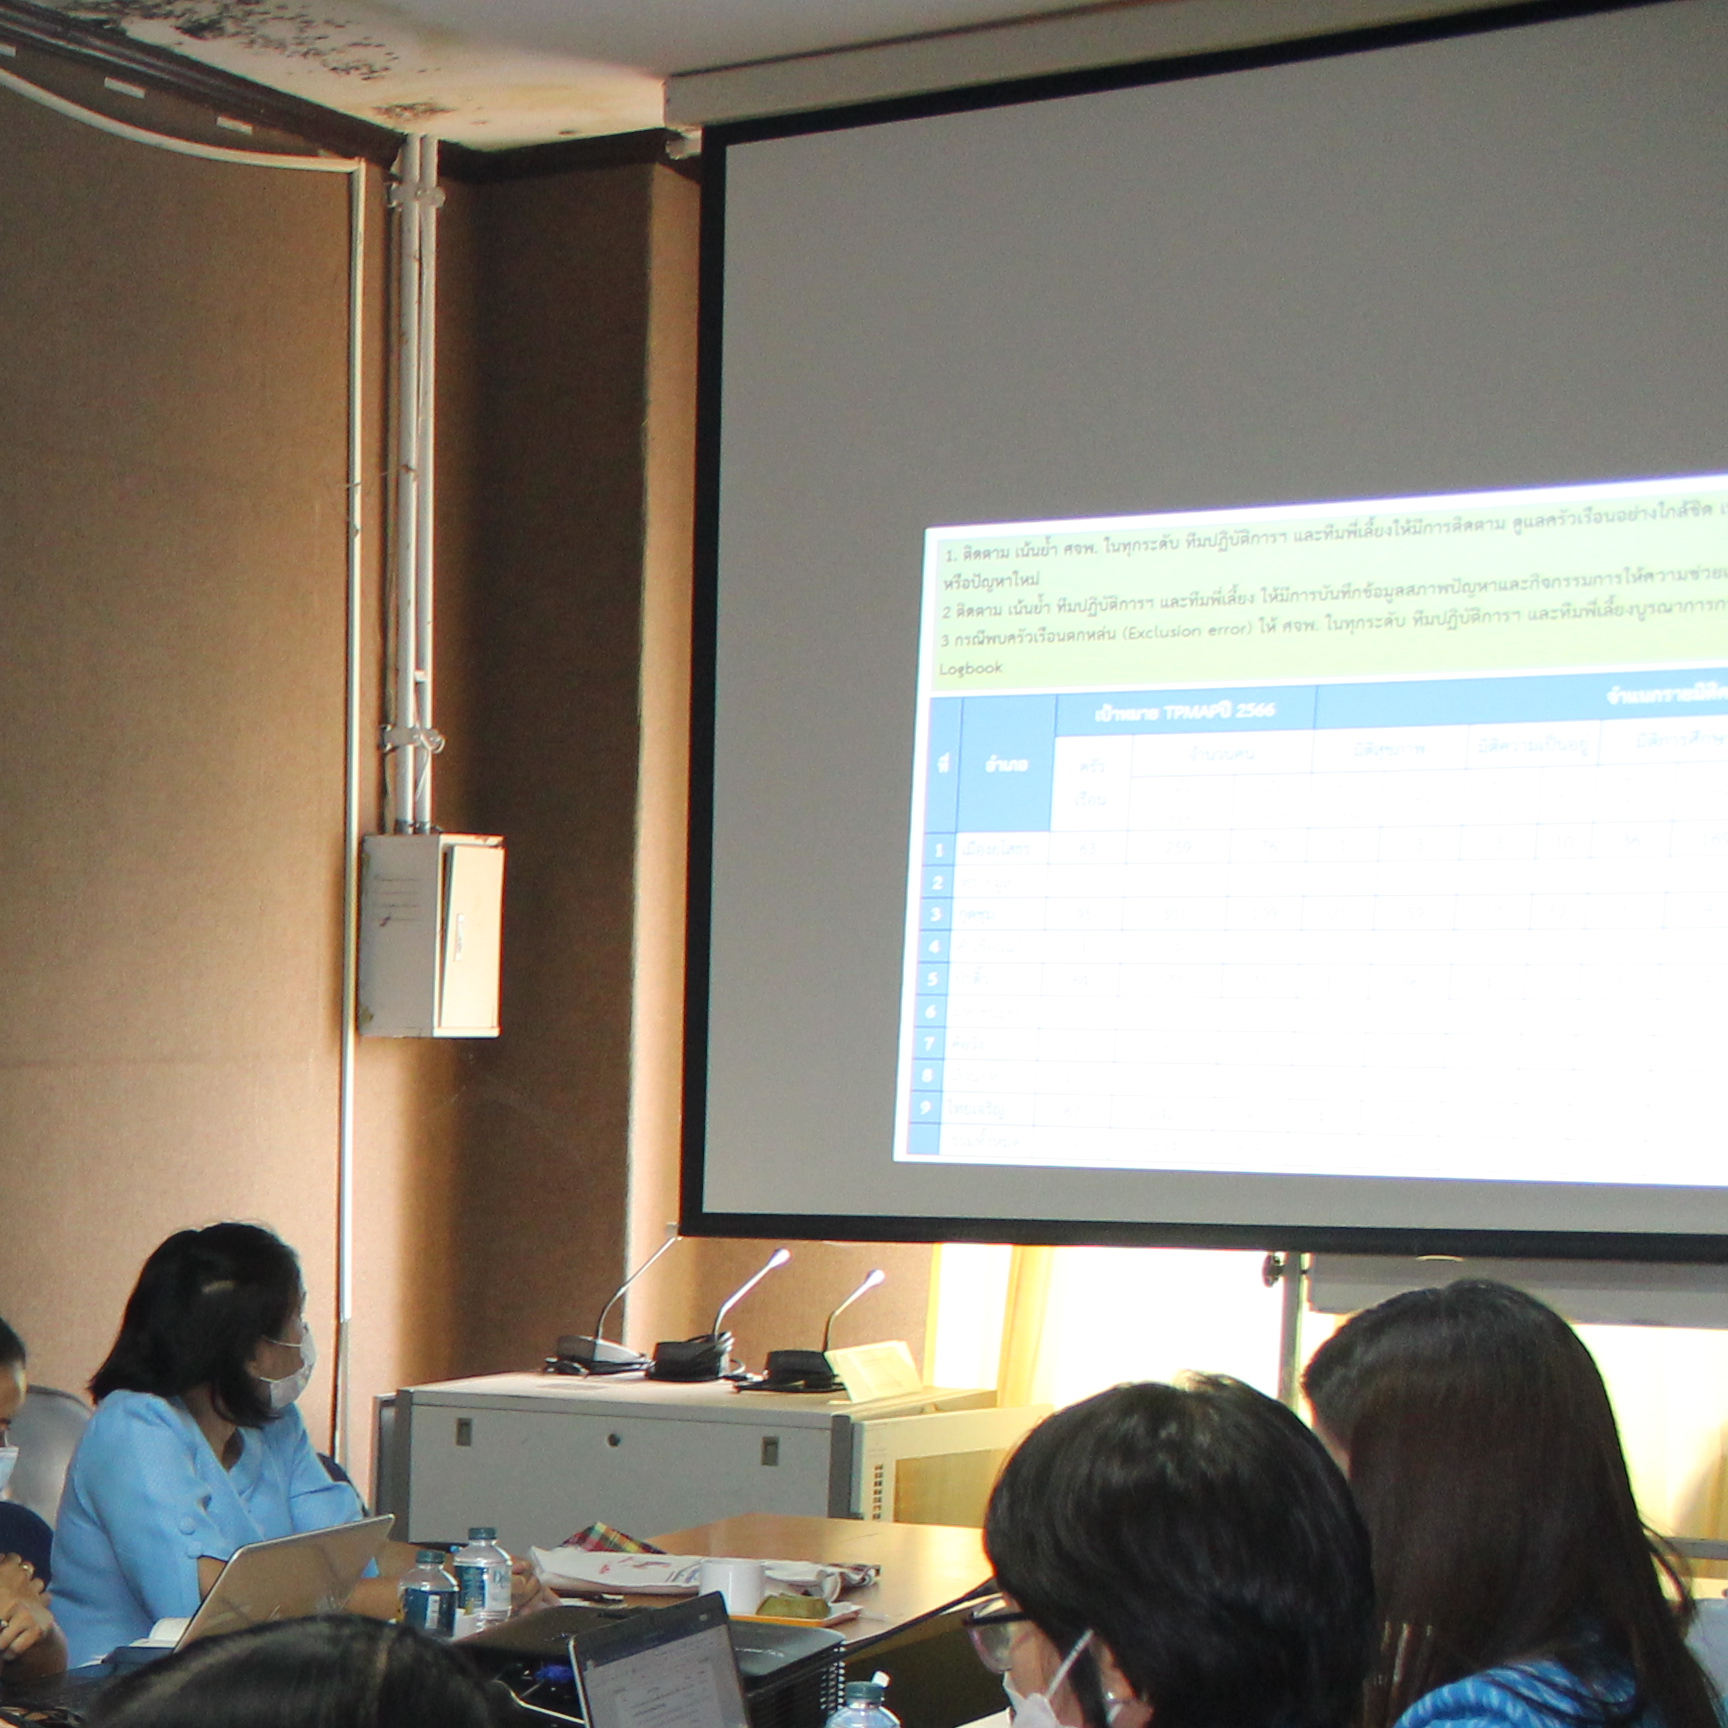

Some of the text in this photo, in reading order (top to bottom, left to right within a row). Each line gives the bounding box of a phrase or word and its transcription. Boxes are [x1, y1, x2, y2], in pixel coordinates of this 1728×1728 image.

[943, 606, 952, 620] 2
[941, 634, 950, 648] 3
[1122, 623, 1202, 642] (Exclusion
[1207, 621, 1253, 637] error)
[938, 660, 1003, 678] Logbook
